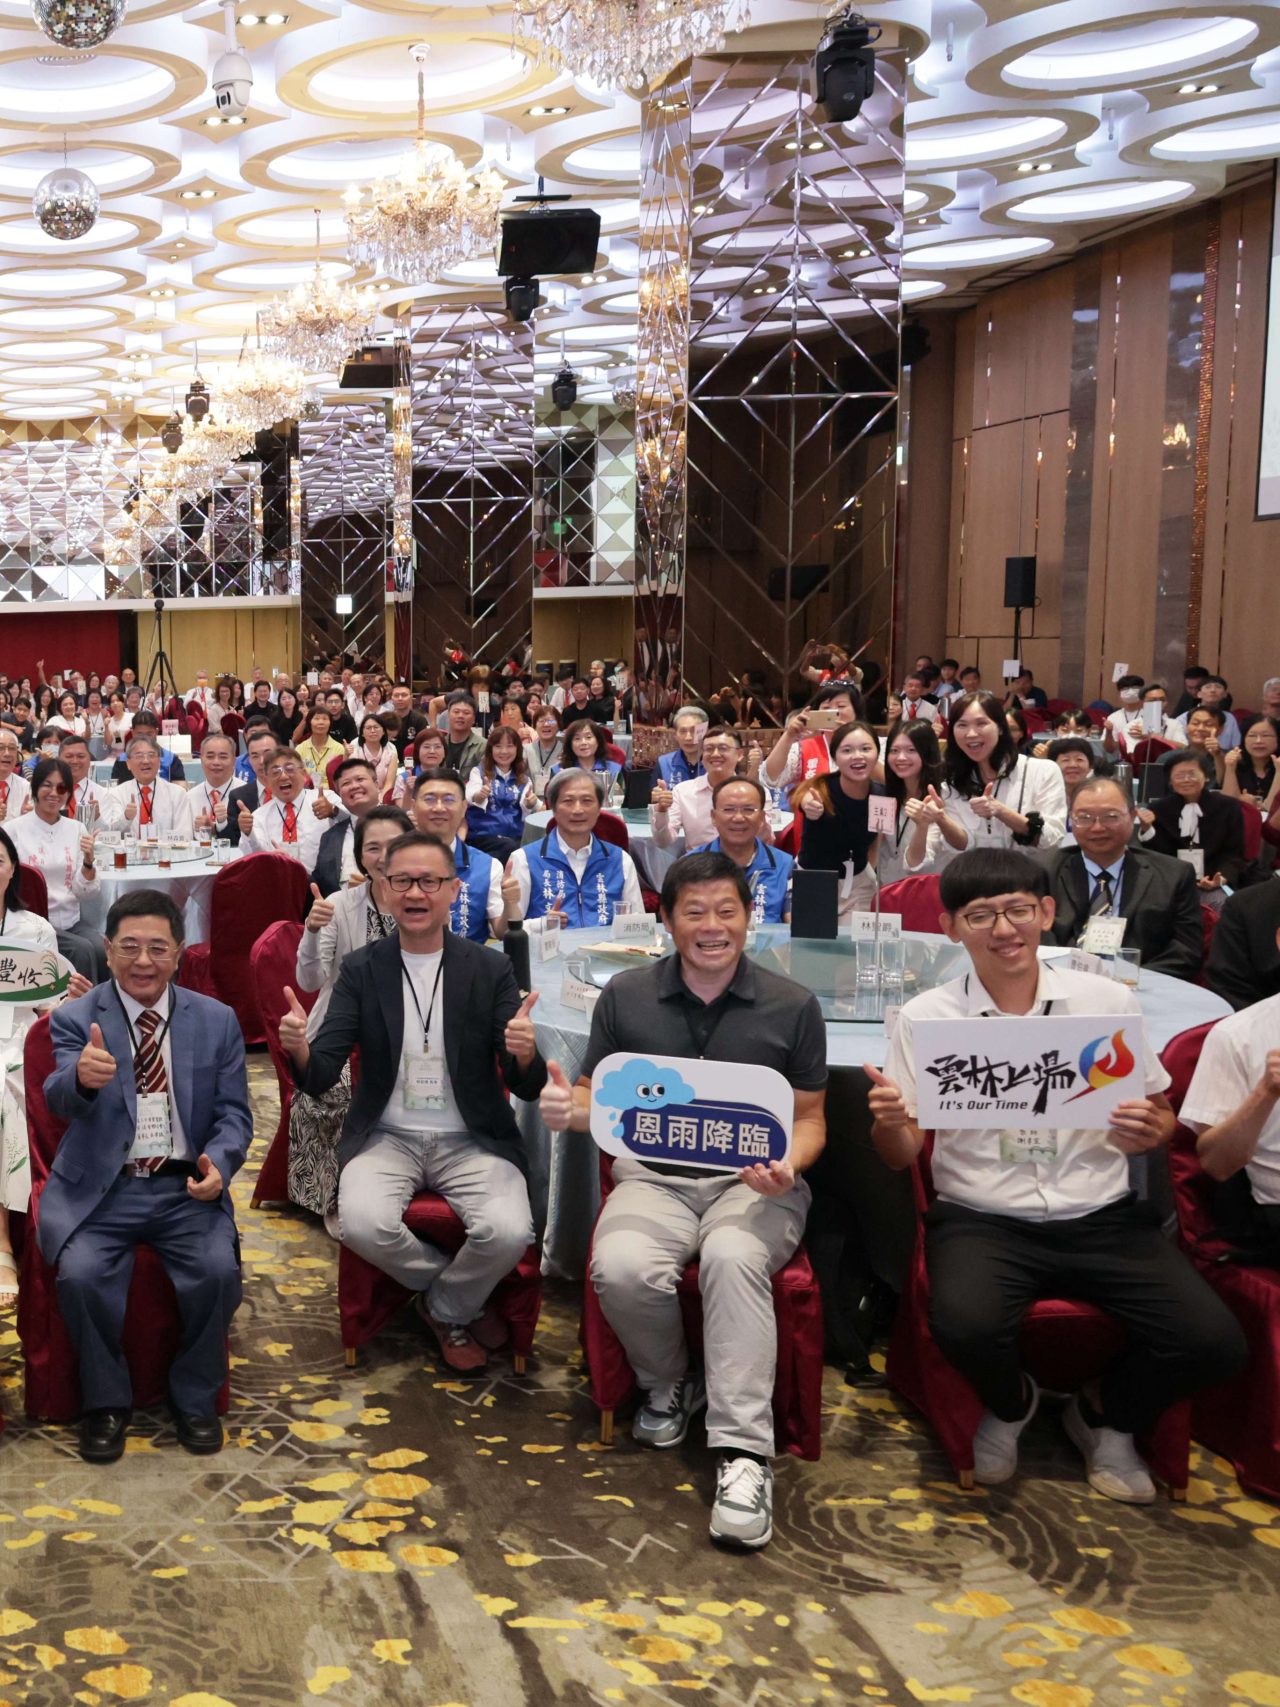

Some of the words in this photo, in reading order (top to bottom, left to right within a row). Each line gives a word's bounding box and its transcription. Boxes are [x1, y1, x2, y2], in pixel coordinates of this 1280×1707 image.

[596, 872, 609, 925] 雲林縣政府
[925, 1050, 1077, 1117] 雲林上場
[939, 1100, 962, 1110] It's
[967, 1100, 992, 1110] Our
[996, 1100, 1028, 1110] Time
[632, 1111, 771, 1159] 恩雨降臨
